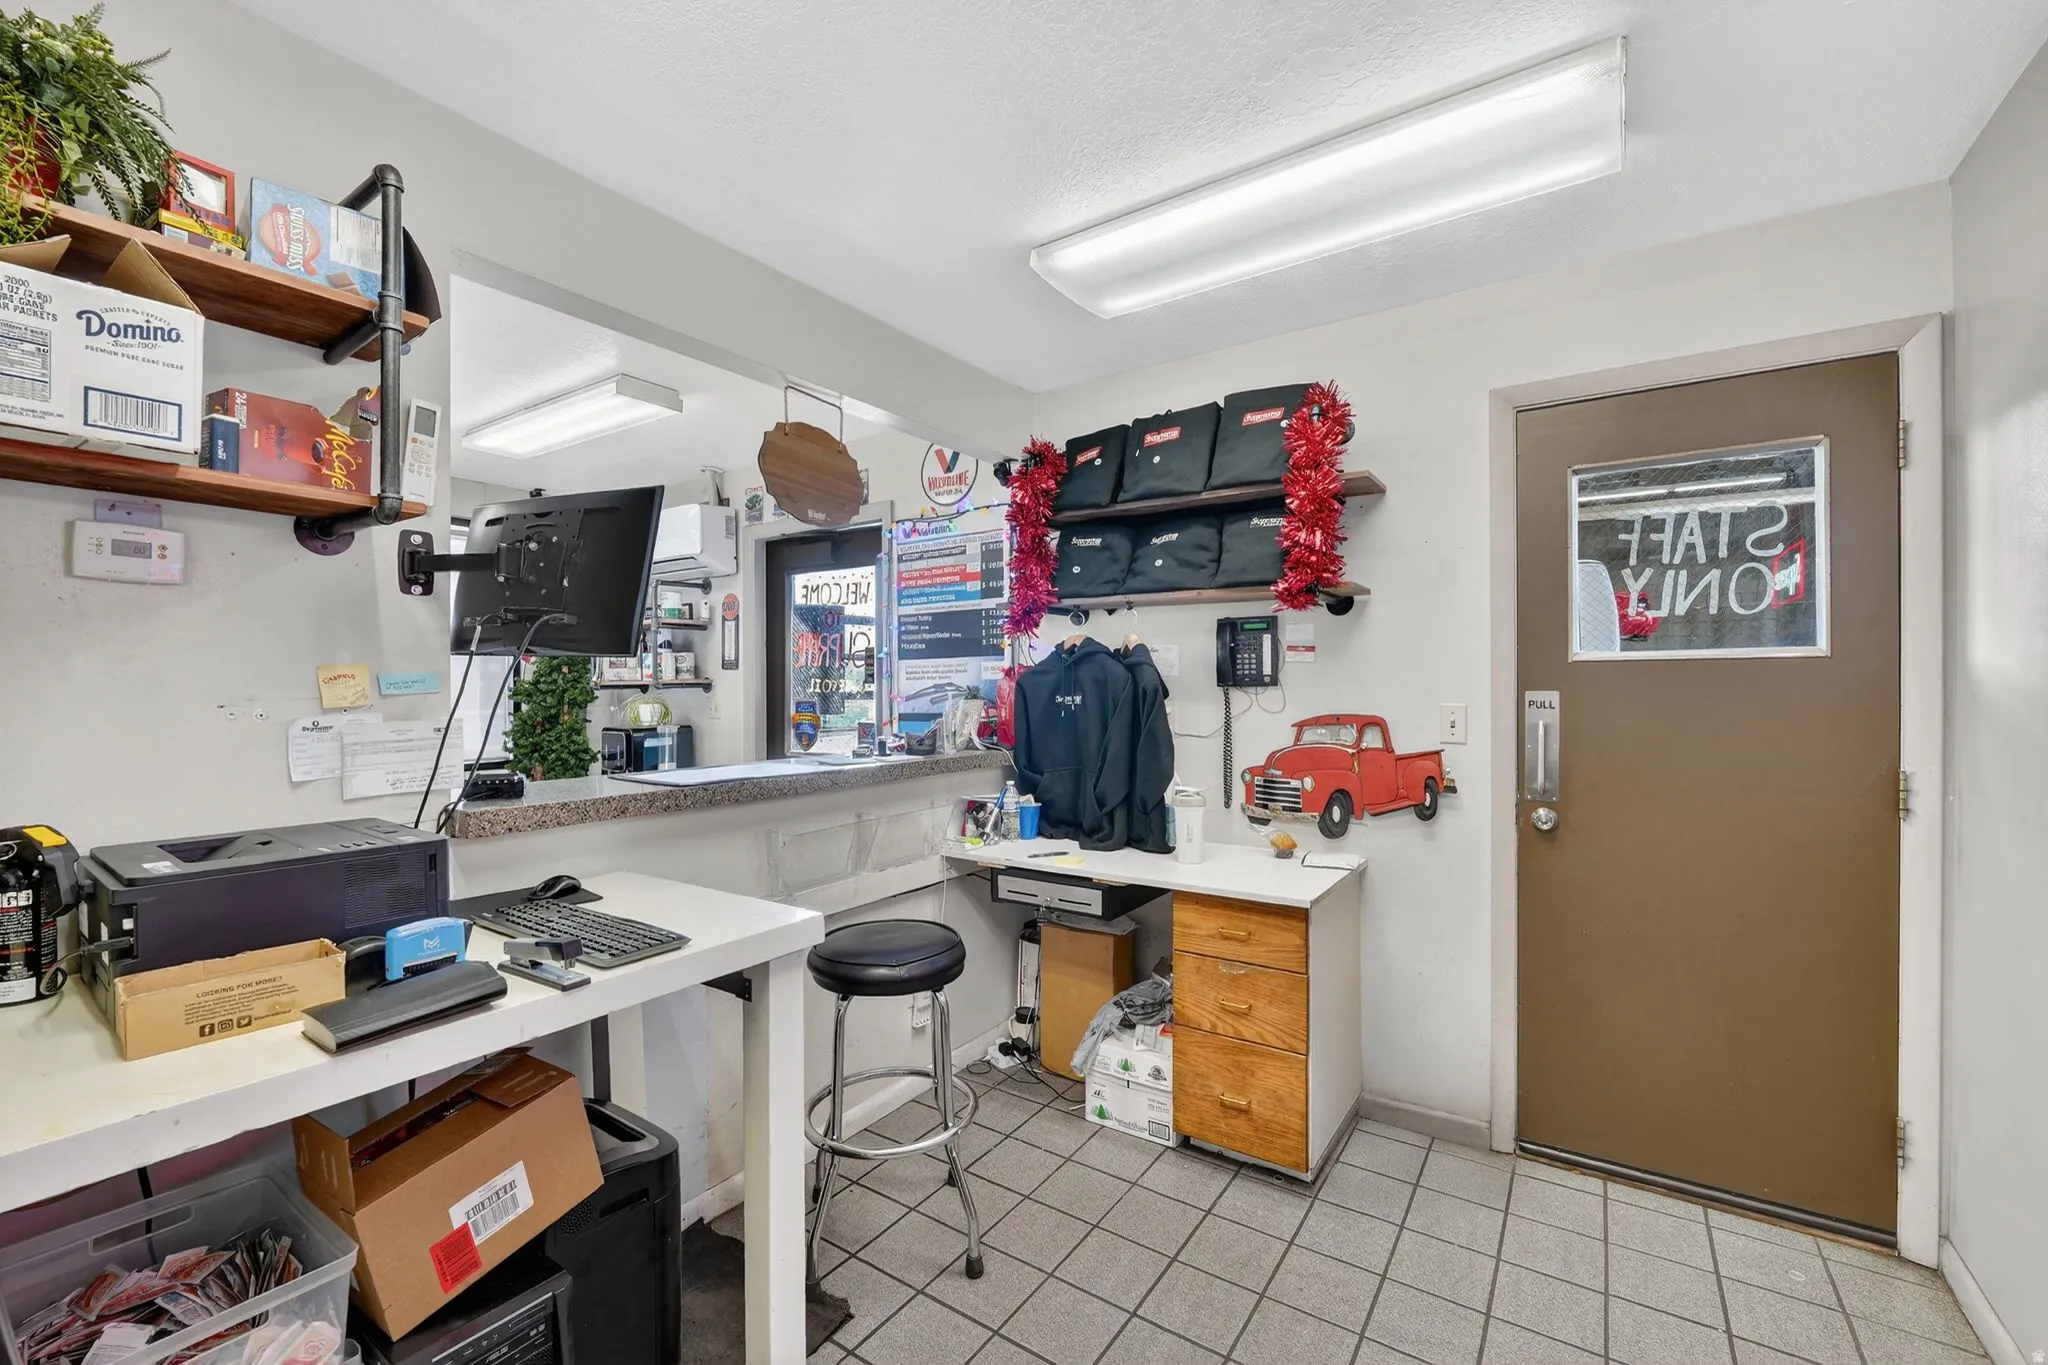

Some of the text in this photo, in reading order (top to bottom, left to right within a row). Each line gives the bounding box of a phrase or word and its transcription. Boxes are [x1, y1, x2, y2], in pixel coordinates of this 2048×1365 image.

[14, 305, 58, 322] PACKETS
[75, 309, 182, 344] Domino
[1528, 700, 1556, 710] PULL
